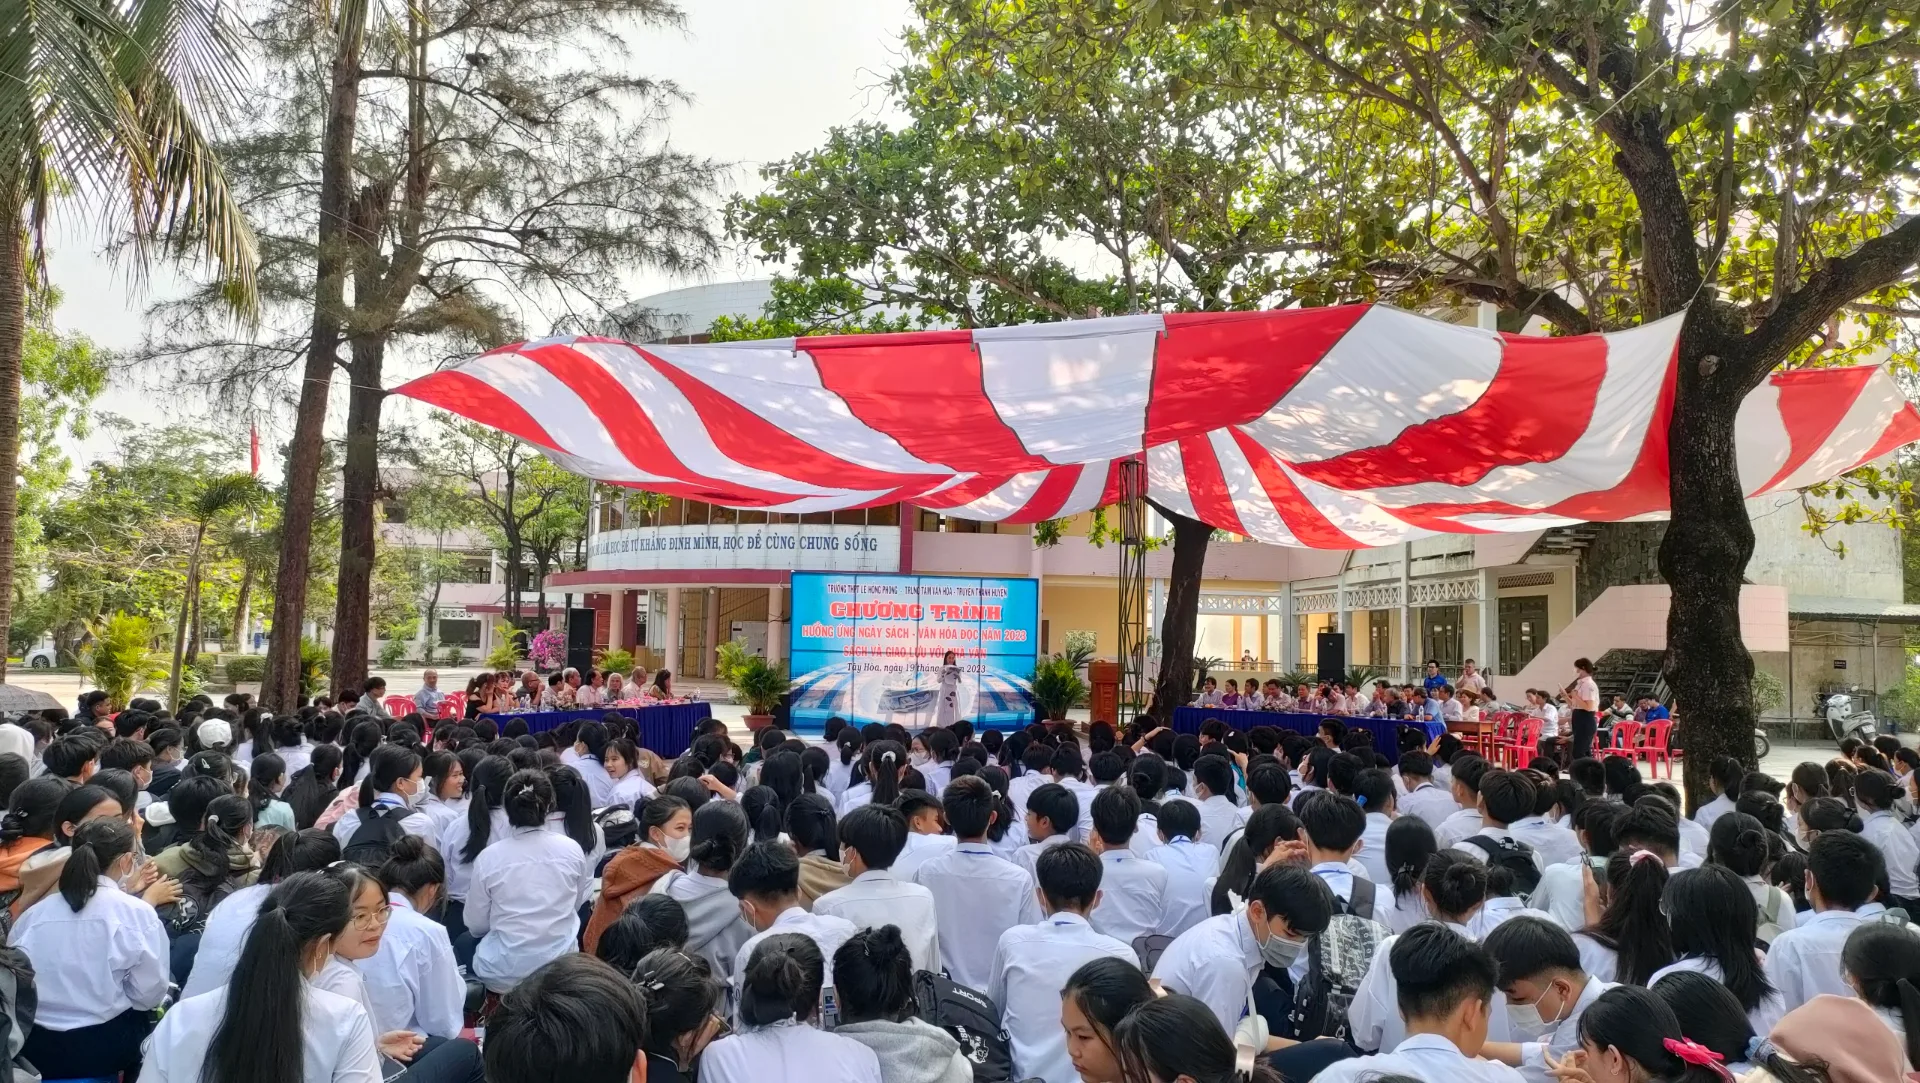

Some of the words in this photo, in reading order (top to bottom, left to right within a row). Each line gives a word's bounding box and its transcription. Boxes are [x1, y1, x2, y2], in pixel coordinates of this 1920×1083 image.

[669, 537, 692, 553] ĐỊNH
[693, 533, 721, 551] MÌNH,
[723, 536, 744, 552] HỌC
[747, 529, 762, 550] ĐỂ
[766, 532, 795, 550] CÙNG
[799, 536, 839, 550] CHUNG
[844, 531, 878, 551] SỐNG
[831, 599, 923, 620] CHƯƠNG
[930, 601, 1002, 621] TRÌNH
[837, 623, 855, 637] ỨNG
[858, 625, 882, 638] NGÀY
[885, 625, 909, 639] SÁCH
[918, 626, 936, 639] VĂN
[939, 626, 957, 640] HÓA
[960, 629, 979, 642] ĐỌC
[981, 627, 1001, 641] NĂM
[1004, 629, 1027, 641] 2023
[843, 644, 868, 657] SÁCH
[871, 643, 882, 657] VÀ
[886, 646, 906, 658] GIAO
[909, 645, 926, 658] LƯU
[847, 662, 862, 673] Tây
[884, 663, 903, 674] ngày
[906, 664, 915, 672] 19
[916, 663, 940, 674] tháng
[967, 664, 986, 673] 2023
[952, 987, 988, 1009] SPORT
